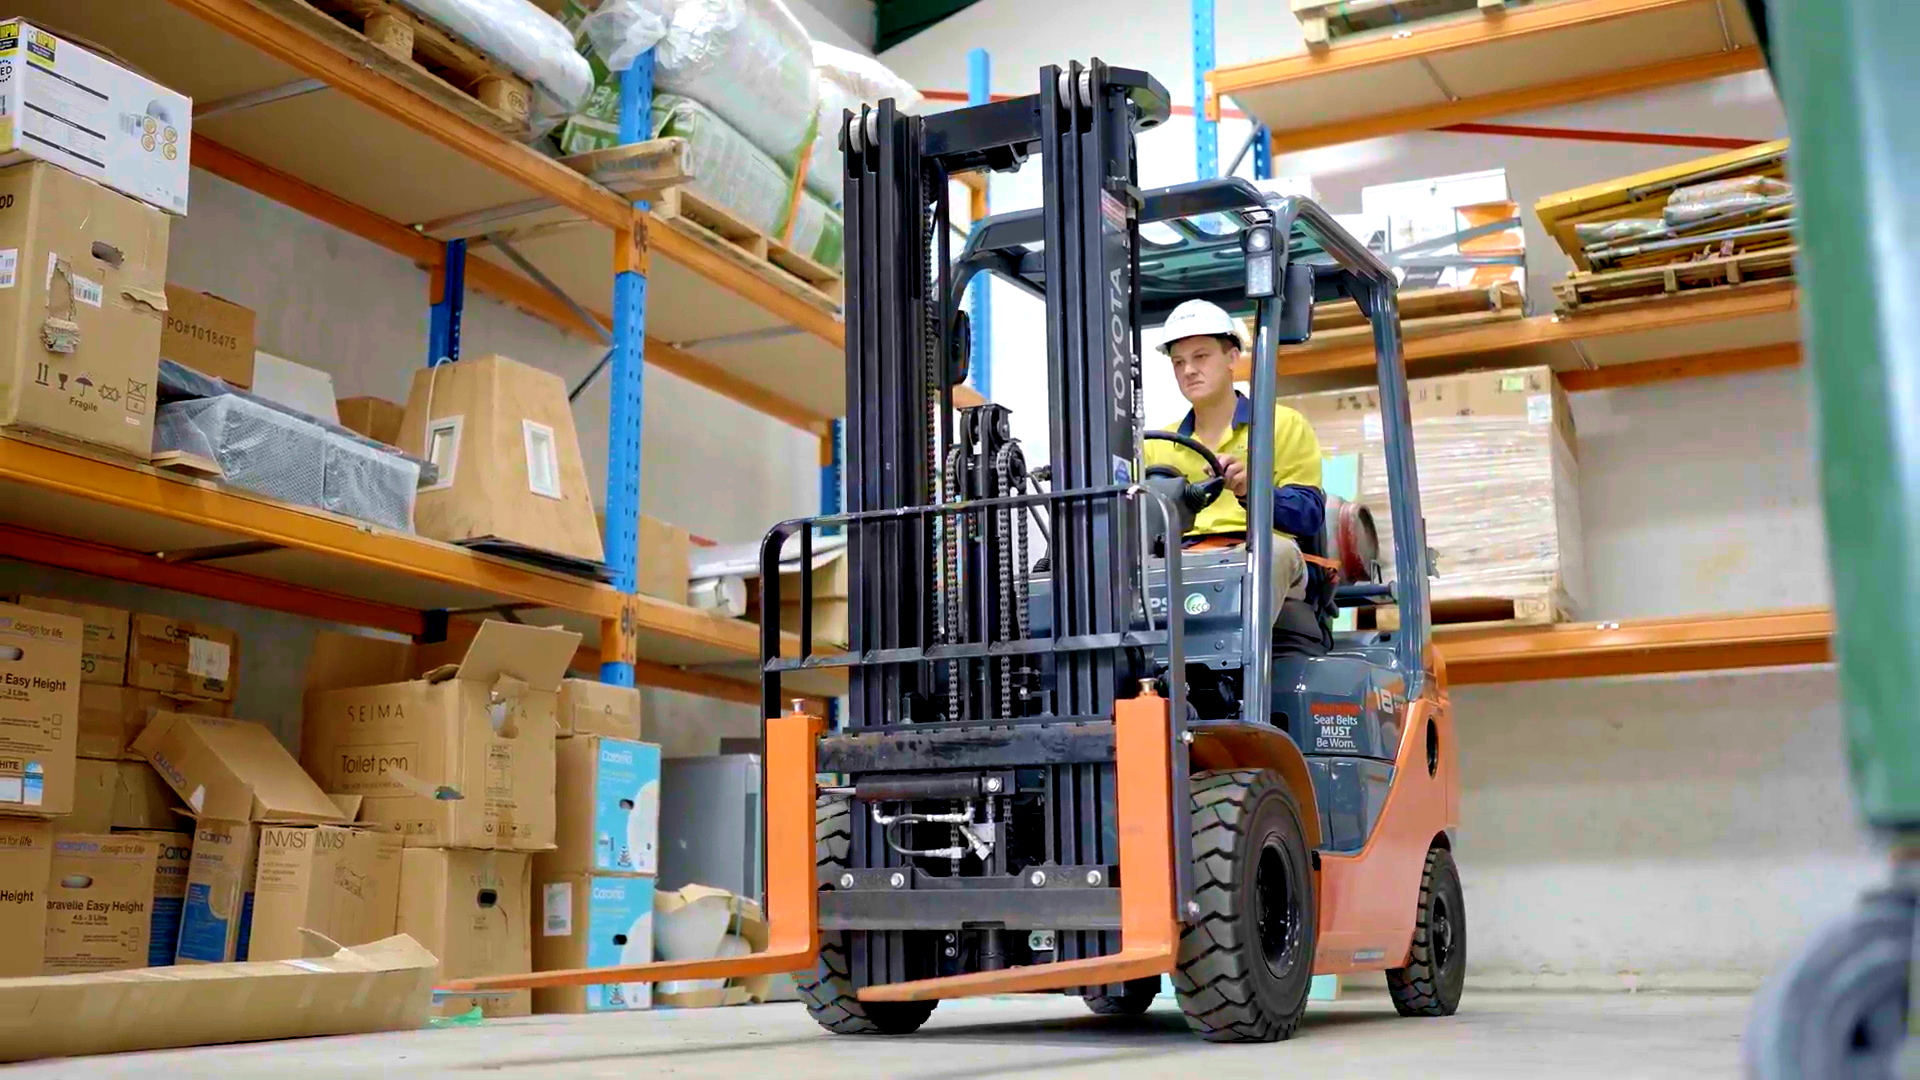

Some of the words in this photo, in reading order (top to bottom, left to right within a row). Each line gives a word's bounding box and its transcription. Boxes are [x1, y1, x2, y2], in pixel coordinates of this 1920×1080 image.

[167, 316, 237, 350] PO#1018475
[1110, 268, 1126, 422] TOYOTA
[69, 396, 98, 412] Fragile
[41, 626, 51, 636] for
[52, 627, 63, 638] life
[6, 673, 31, 688] Easy
[33, 676, 66, 692] Height
[348, 704, 404, 722] SEIMA
[1314, 714, 1334, 725] Seat
[1336, 715, 1357, 725] Belts
[1321, 726, 1351, 736] MUST
[1316, 738, 1328, 748] Be
[1329, 738, 1356, 748] Worn.
[342, 754, 376, 774] Toilet
[379, 756, 408, 776] pan
[8, 837, 19, 846] for
[20, 836, 32, 846] life
[264, 831, 307, 848] INVISI
[0, 890, 34, 904] Height
[86, 900, 110, 914] Easy
[112, 901, 144, 914] Height
